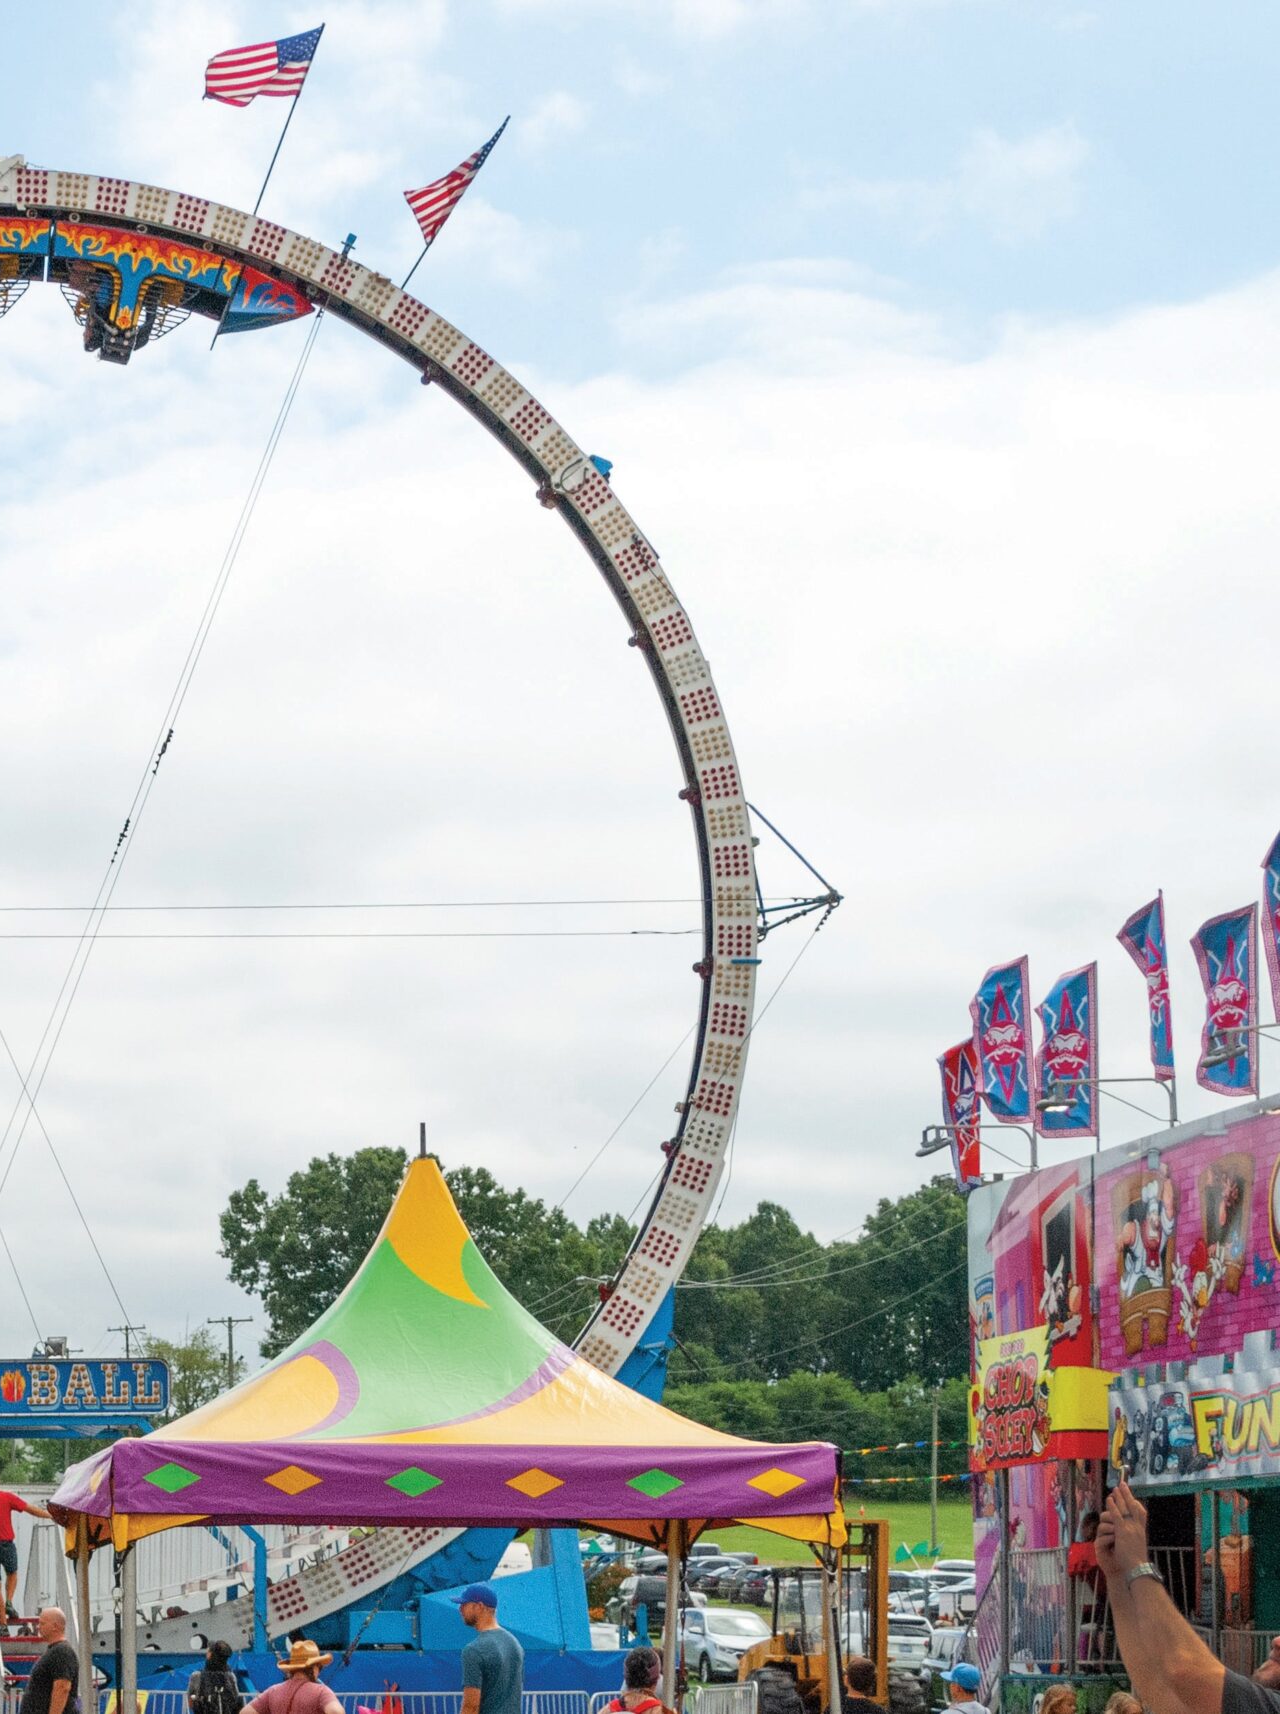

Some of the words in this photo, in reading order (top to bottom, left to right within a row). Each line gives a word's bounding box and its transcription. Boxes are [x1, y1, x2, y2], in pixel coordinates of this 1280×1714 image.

[27, 1363, 161, 1406] BALL
[985, 1354, 1038, 1410] CHOP
[984, 1407, 1037, 1460] SUEY
